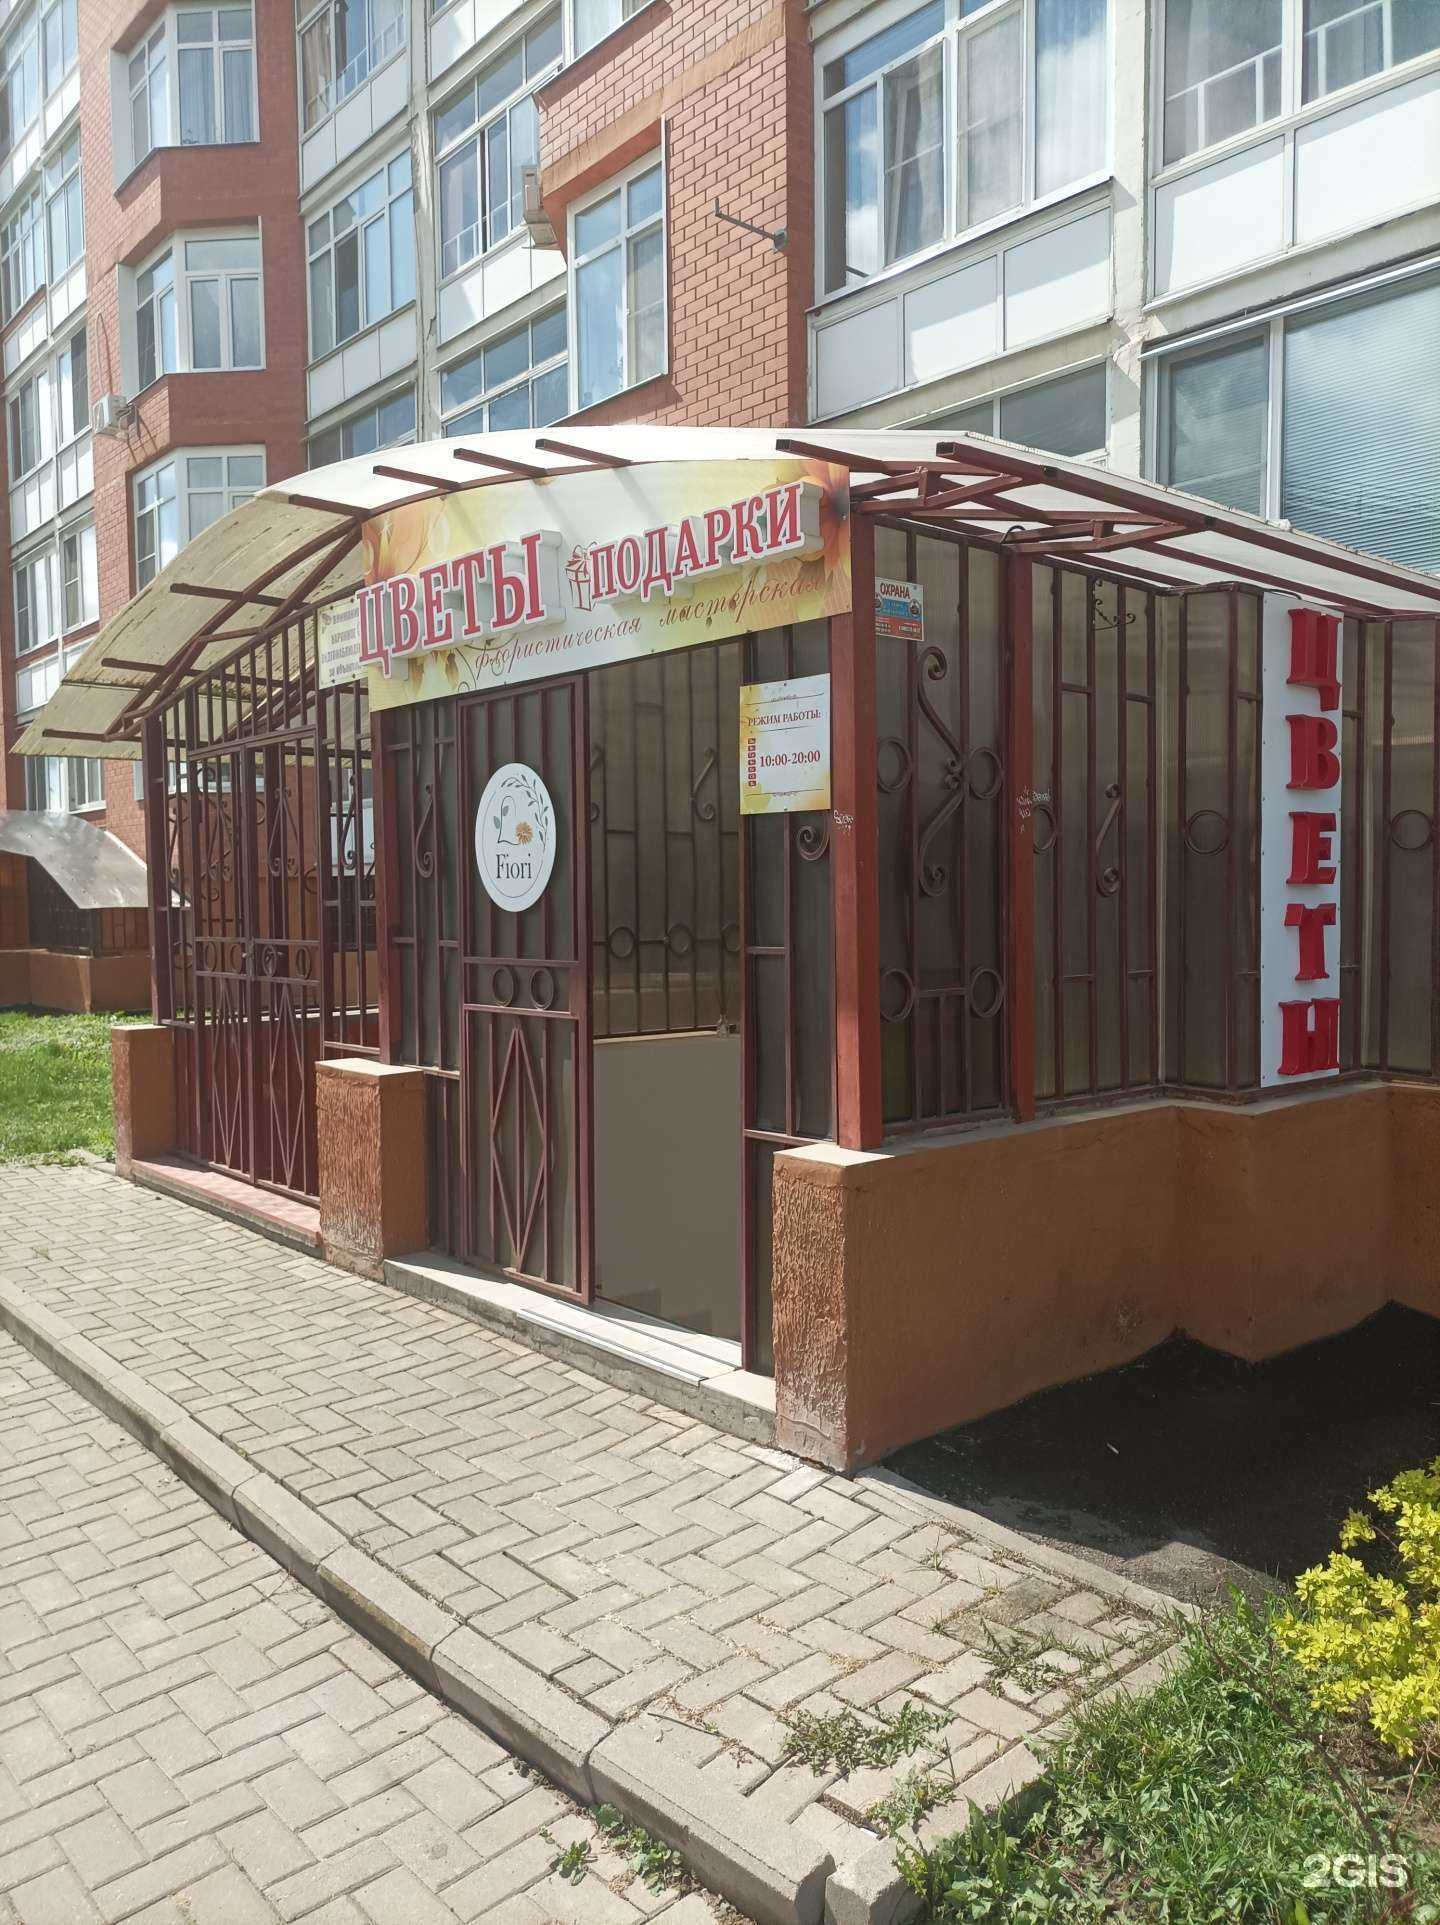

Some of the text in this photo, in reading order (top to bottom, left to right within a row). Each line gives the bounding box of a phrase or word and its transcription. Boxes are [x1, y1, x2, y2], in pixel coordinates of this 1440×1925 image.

[356, 482, 804, 676] ЦВЕТЫ ПОДАРКИ
[880, 582, 911, 599] ОХРАНА
[475, 565, 834, 680] флористическая мастерская
[747, 709, 821, 727] РЕЖИМ РАБОТЫ:
[760, 750, 821, 767] 10:00-20:00
[1278, 607, 1343, 1077] ЦВЕТЫ
[496, 853, 532, 880] Fiori
